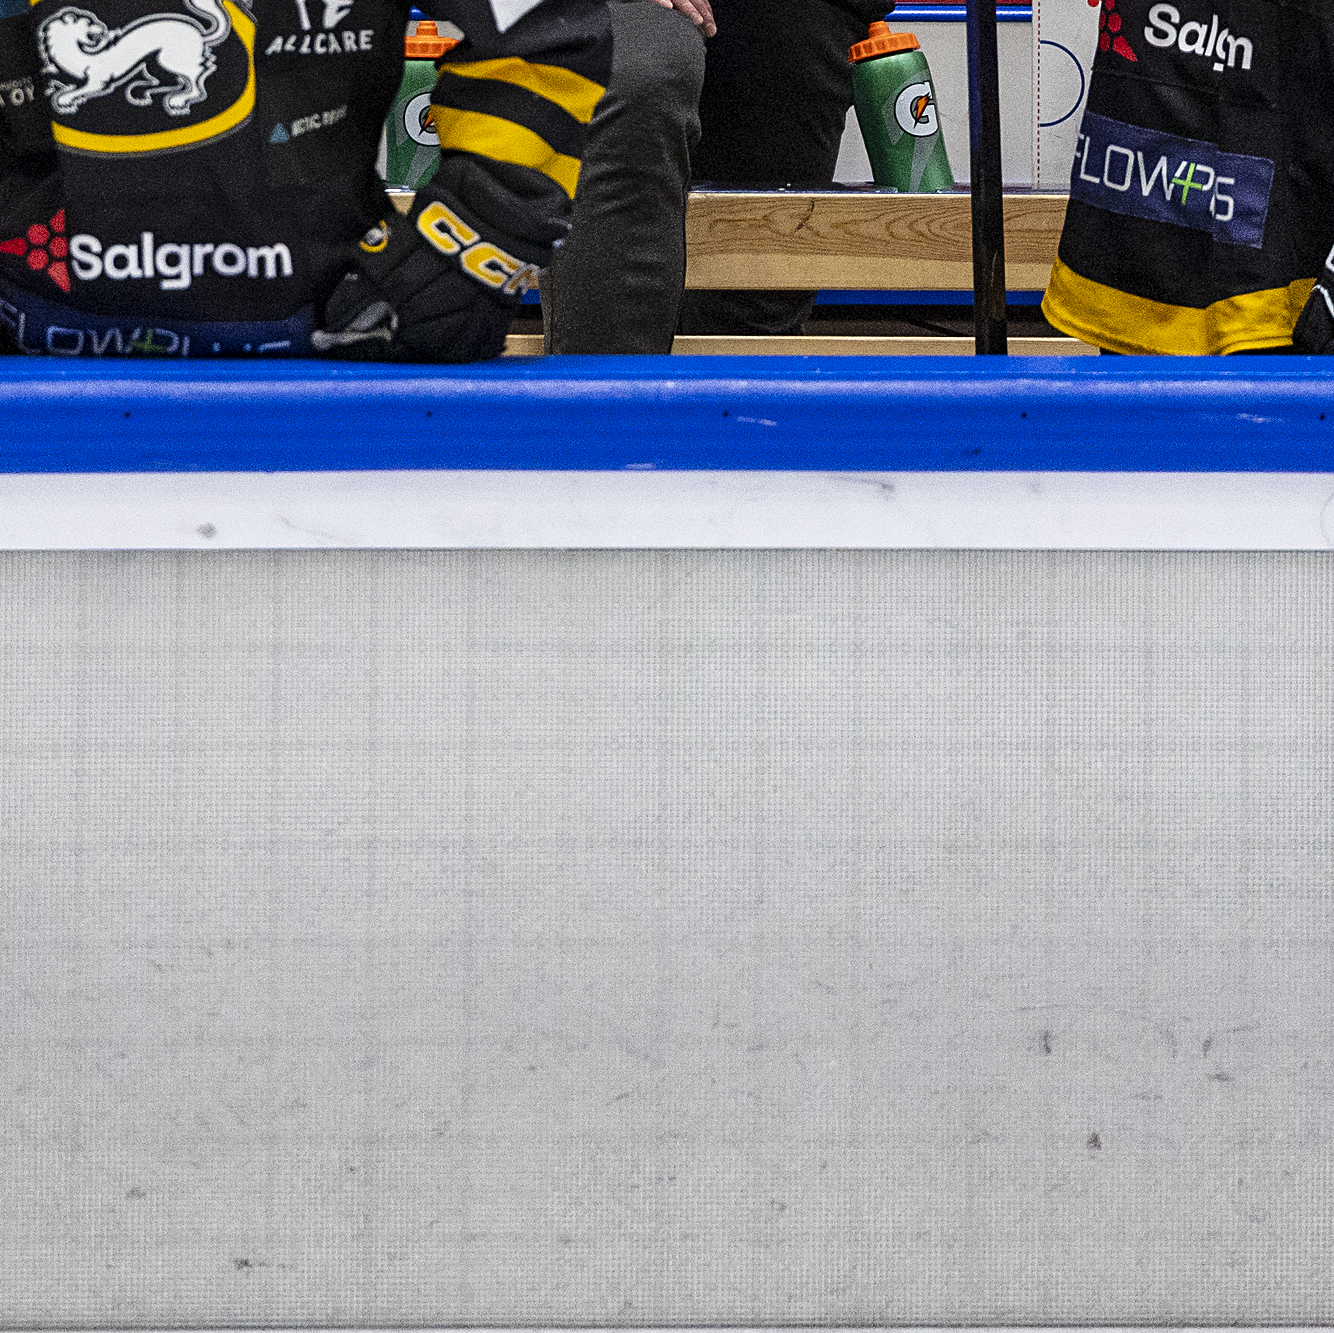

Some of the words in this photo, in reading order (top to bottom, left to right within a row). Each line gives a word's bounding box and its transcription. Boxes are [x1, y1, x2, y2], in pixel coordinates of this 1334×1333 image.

[266, 30, 374, 55] ALLCARE
[894, 81, 940, 138] G
[69, 231, 294, 291] Salgrom
